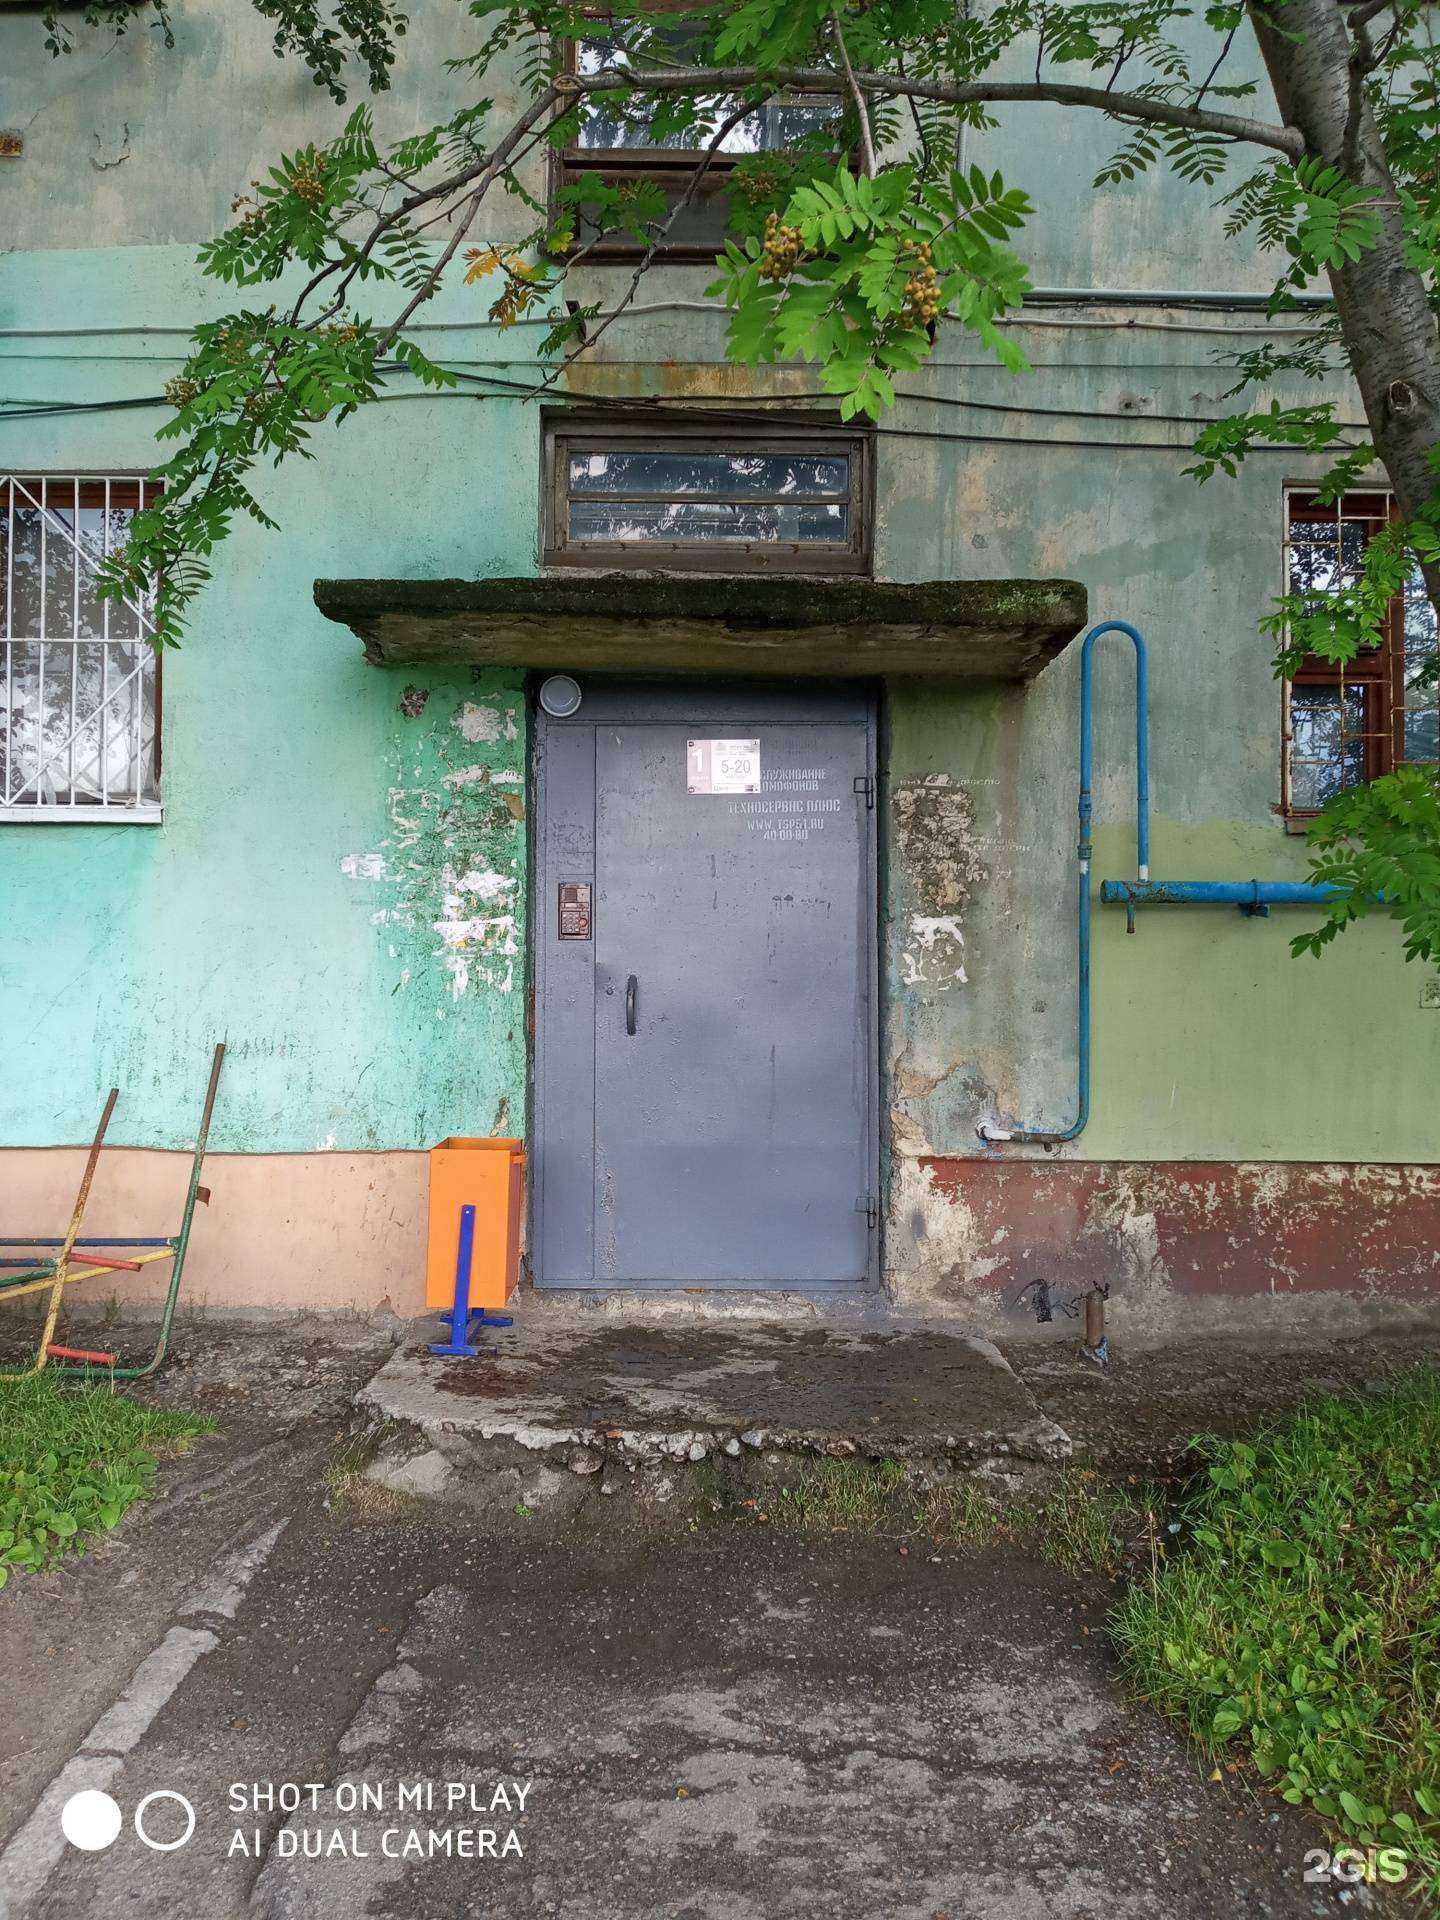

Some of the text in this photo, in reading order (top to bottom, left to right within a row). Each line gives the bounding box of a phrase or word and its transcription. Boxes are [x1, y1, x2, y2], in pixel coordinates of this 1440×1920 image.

[690, 748, 704, 773] 1
[721, 759, 751, 774] 5-20
[762, 780, 819, 791] ОМОФОНОВ
[806, 799, 841, 812] ПЛЮС
